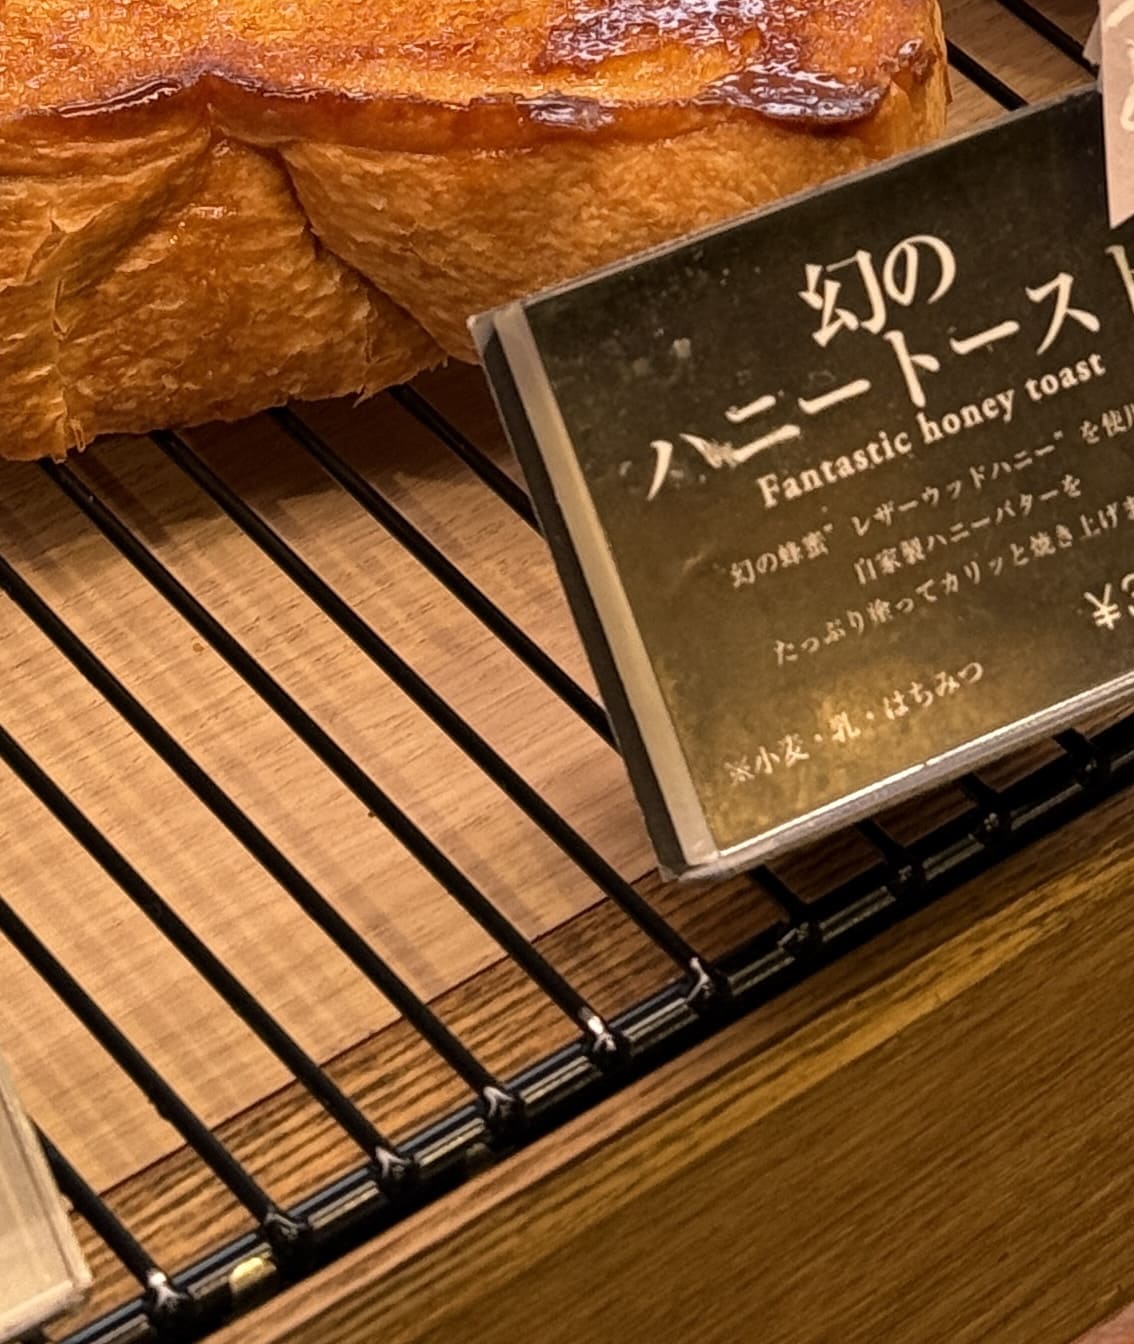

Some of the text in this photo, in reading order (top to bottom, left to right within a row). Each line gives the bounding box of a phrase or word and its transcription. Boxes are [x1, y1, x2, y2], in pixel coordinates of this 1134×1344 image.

[798, 235, 957, 347] 幻の
[756, 354, 1106, 509] Fantastic honey toast
